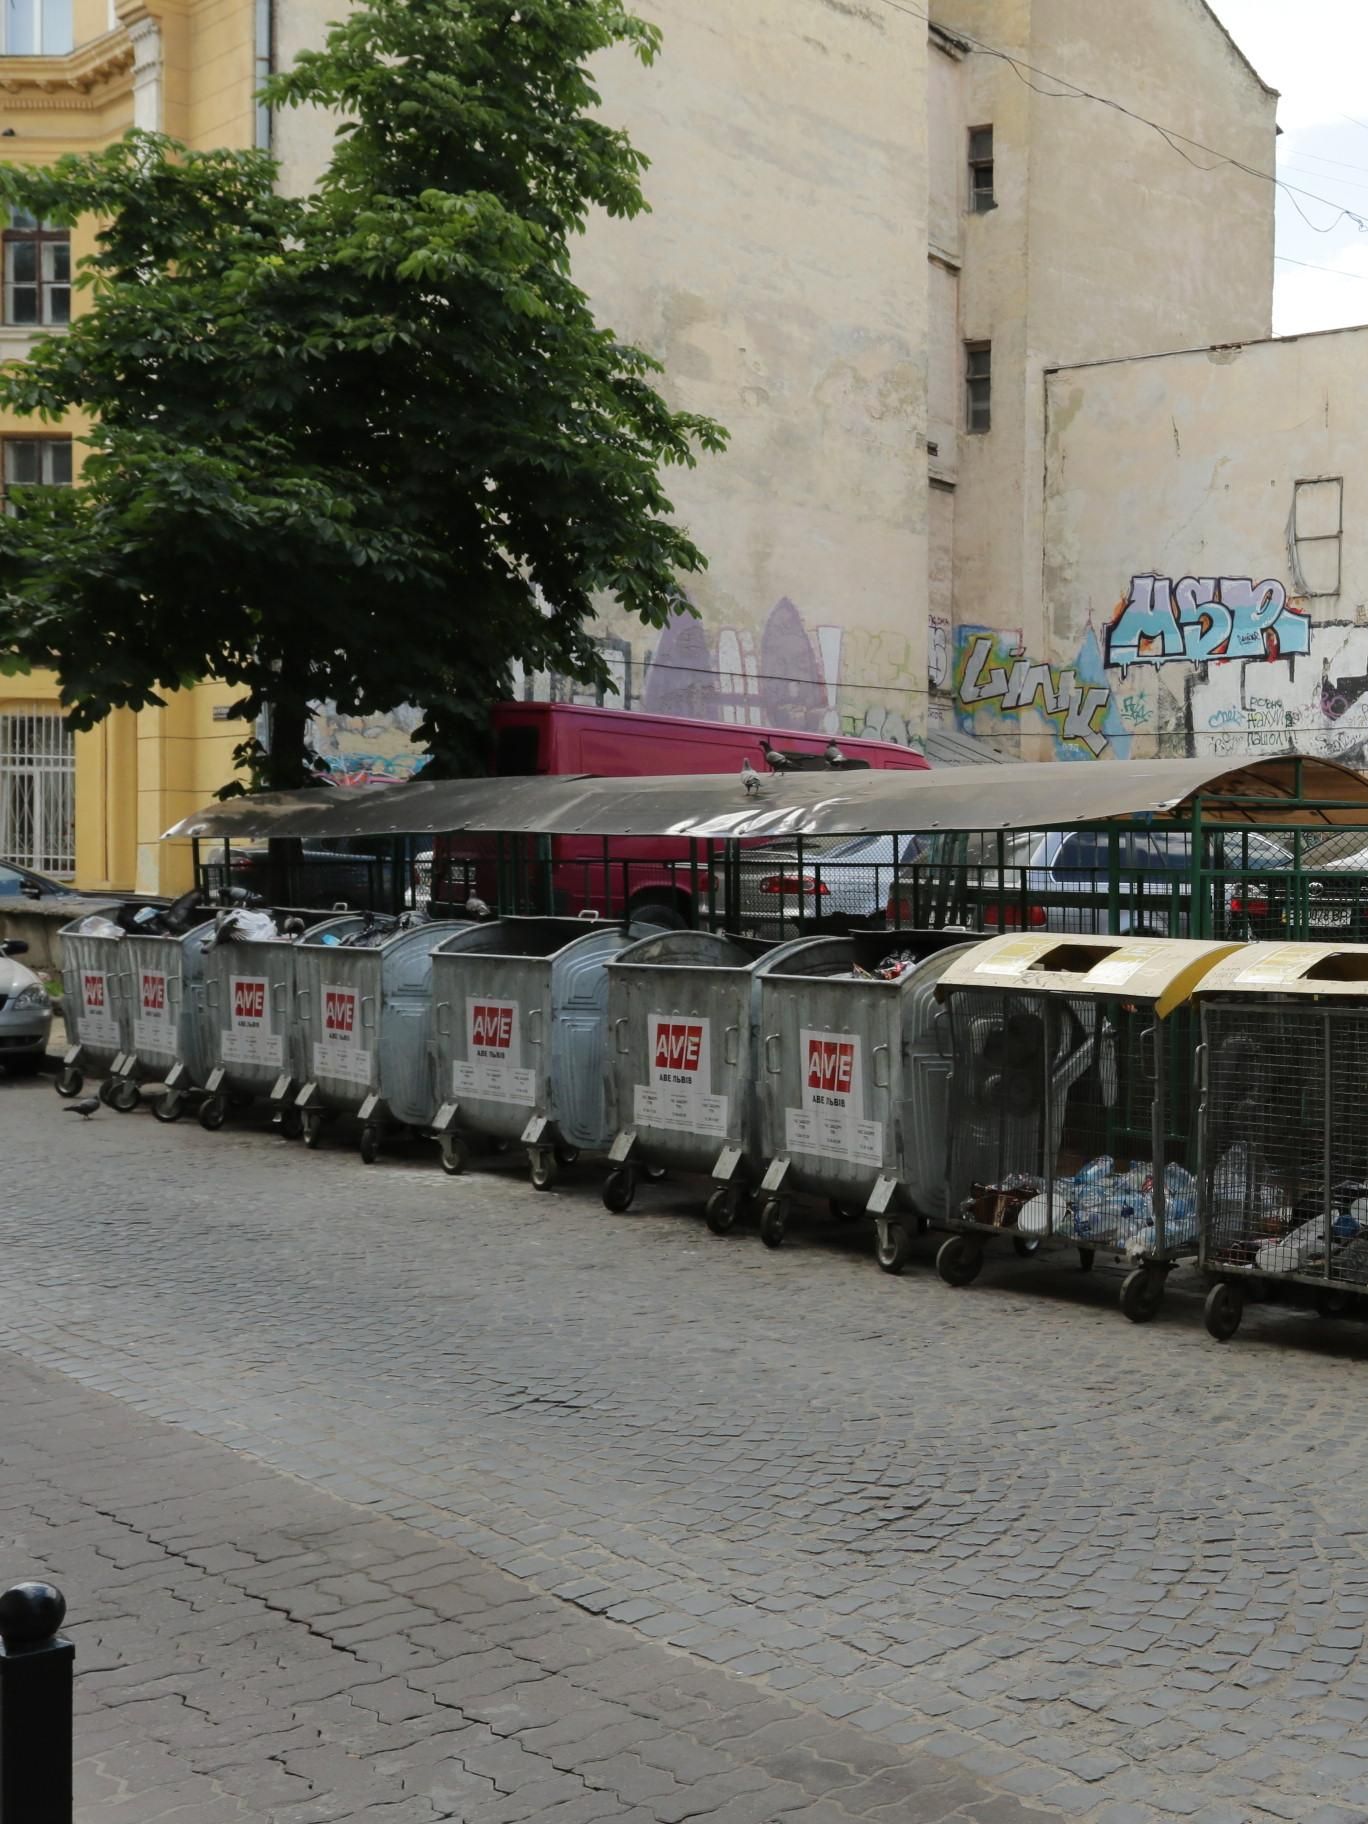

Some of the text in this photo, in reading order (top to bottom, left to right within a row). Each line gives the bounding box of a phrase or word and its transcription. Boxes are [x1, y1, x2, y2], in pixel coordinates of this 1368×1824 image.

[472, 1015, 511, 1039] AVE
[655, 1033, 701, 1061] AVE
[808, 1050, 852, 1082] AVE
